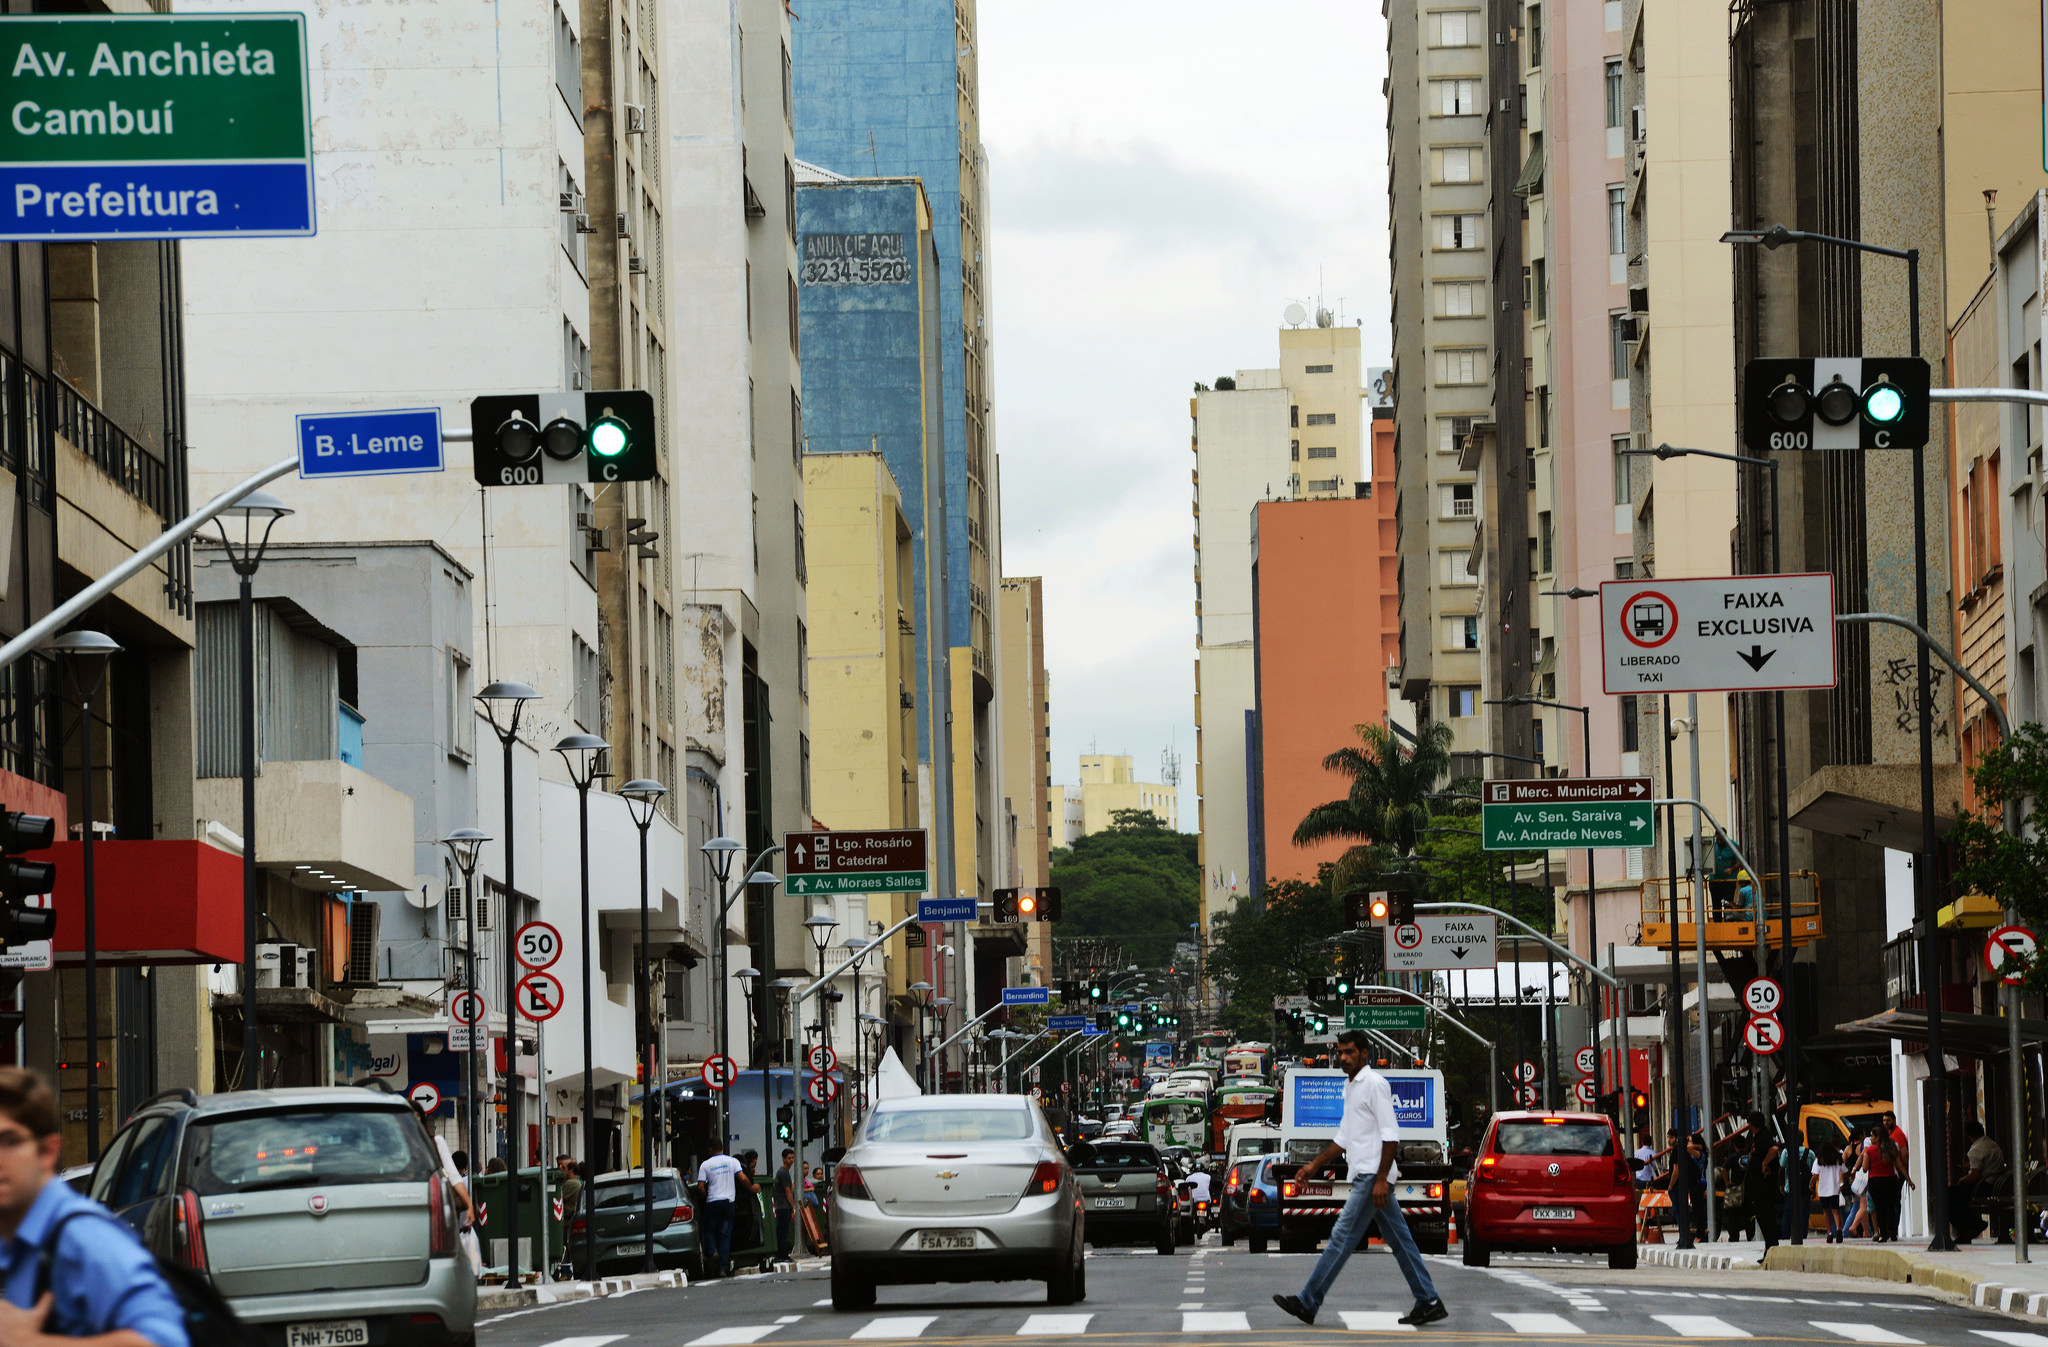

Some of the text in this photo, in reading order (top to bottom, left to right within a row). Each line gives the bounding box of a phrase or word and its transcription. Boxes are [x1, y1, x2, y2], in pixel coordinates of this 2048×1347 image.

[12, 41, 276, 77] Av. Anchieta
[12, 100, 174, 135] Cambuí
[15, 182, 219, 217] Prefeitura
[807, 234, 904, 256] ANUNCIE AQUI
[806, 261, 905, 282] 3234-5520
[315, 433, 424, 456] B. Leme
[1770, 430, 1891, 450] 600 C
[501, 464, 618, 485] 600 C
[1724, 591, 1785, 609] FAIXA
[1698, 616, 1814, 637] EXCLUSIVA
[1620, 655, 1680, 666] LIBERADO
[1637, 672, 1663, 682] TAXI
[1516, 784, 1622, 799] Merc. Municipal
[1514, 810, 1622, 823] Av. Sen. Saraiva
[1496, 828, 1622, 842] Av. Andrade Neves
[835, 836, 912, 852] Lgo. Rosário
[837, 855, 888, 866] Catedral
[815, 876, 922, 889] Av. Moraes Salles
[924, 905, 970, 916] Benjamin
[1003, 915, 1018, 923] 169
[1356, 920, 1370, 928] 169
[1445, 923, 1474, 931] FAIXA
[523, 934, 553, 954] 50
[1431, 935, 1487, 944] EXCLUSIVA
[531, 982, 547, 1010] E
[1751, 987, 1775, 1003] 50
[1371, 1018, 1408, 1026] Aquidaban
[1757, 1023, 1771, 1046] E
[366, 1054, 395, 1071] ogal
[1392, 1094, 1424, 1109] Azul
[68, 1108, 104, 1121] 142
